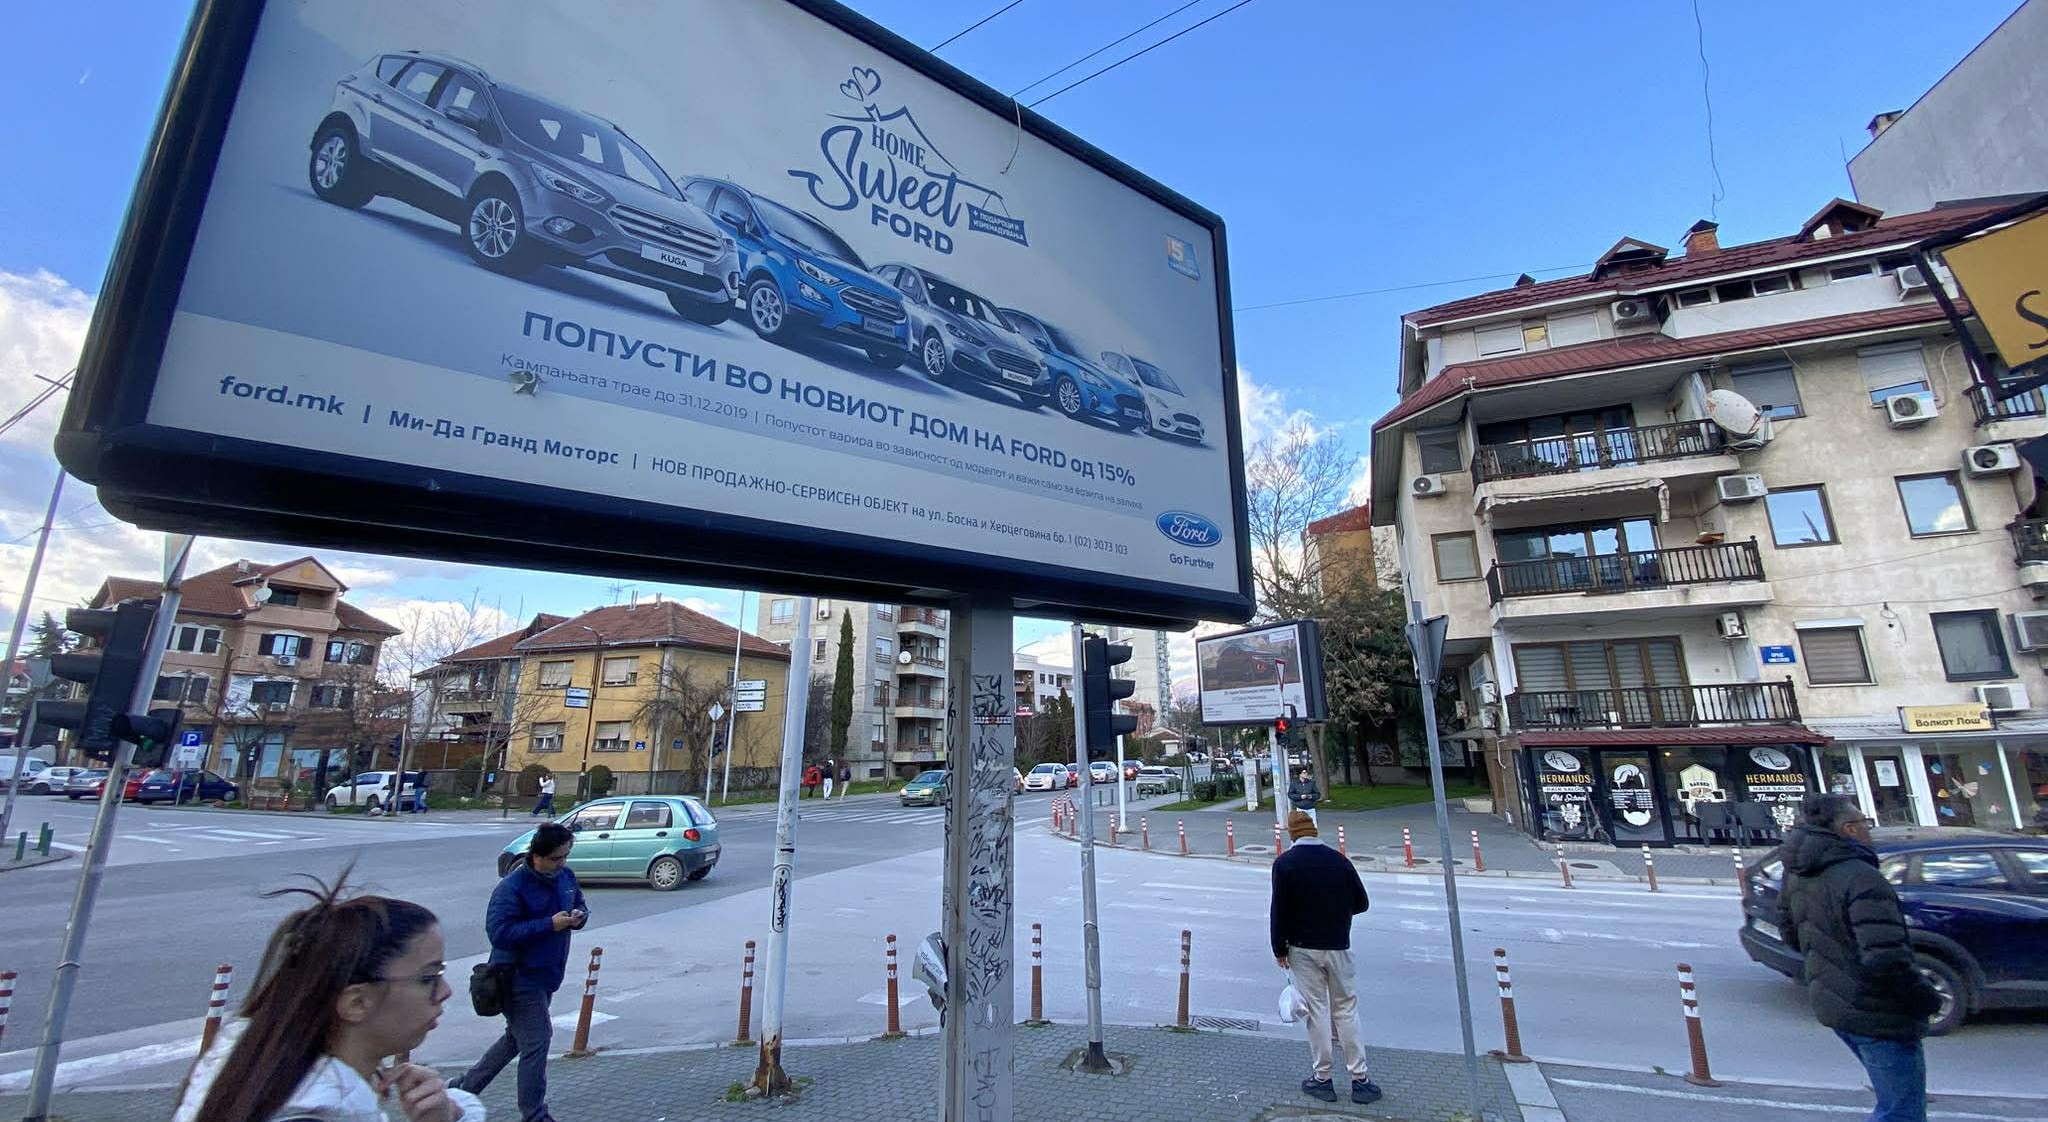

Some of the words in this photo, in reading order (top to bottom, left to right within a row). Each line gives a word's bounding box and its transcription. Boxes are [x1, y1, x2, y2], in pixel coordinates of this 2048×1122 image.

[871, 123, 926, 169] HOME
[788, 125, 961, 227] Sweet
[871, 203, 953, 254] FORD
[661, 252, 688, 267] KUGA
[523, 311, 716, 382] ПОПУСТИ
[726, 363, 772, 395] ВО
[780, 378, 904, 427] НОВИОТ
[909, 412, 968, 445] ДОМ
[974, 429, 1005, 455] НА
[1011, 438, 1067, 469] FORD
[1071, 458, 1095, 480] од
[1098, 461, 1136, 486] 15%
[501, 353, 607, 388] Кампањата
[612, 379, 651, 397] трае
[654, 390, 676, 404] до
[678, 392, 747, 420] 31.12.2019
[765, 414, 826, 437] Попустот
[829, 430, 873, 449] варира
[876, 440, 890, 451] во
[893, 445, 947, 465] зависност
[950, 458, 964, 470] од
[965, 463, 1006, 478] моделот
[1008, 472, 1015, 480] и
[1016, 474, 1040, 486] важи
[1041, 480, 1063, 491] само
[219, 375, 345, 415] ford.mk
[389, 410, 465, 438] Ми-Да
[471, 425, 537, 454] Гранд
[543, 439, 619, 464] Моторс
[652, 457, 687, 476] НОВ
[691, 464, 860, 506] ПРОДАЖНО-СЕРВИСЕН
[863, 496, 908, 514] ОБЈЕКТ
[912, 507, 925, 518] на
[928, 510, 944, 521] ул.
[947, 511, 978, 528] Босна
[981, 520, 987, 529] и
[989, 519, 1051, 541] Херцеговина
[1053, 531, 1067, 544] бр.
[1074, 534, 1092, 549] (02)
[1094, 536, 1113, 553] 3073
[1115, 543, 1129, 556] 103
[1170, 515, 1210, 542] Ford
[1169, 553, 1183, 564] Go
[1183, 555, 1215, 570] Further
[1540, 774, 1591, 784] HERMANOS
[1745, 773, 1804, 784] HERMANOS
[1550, 793, 1563, 802] Old
[1564, 793, 1587, 803] School
[1754, 794, 1776, 803] New
[1777, 793, 1804, 802] School
